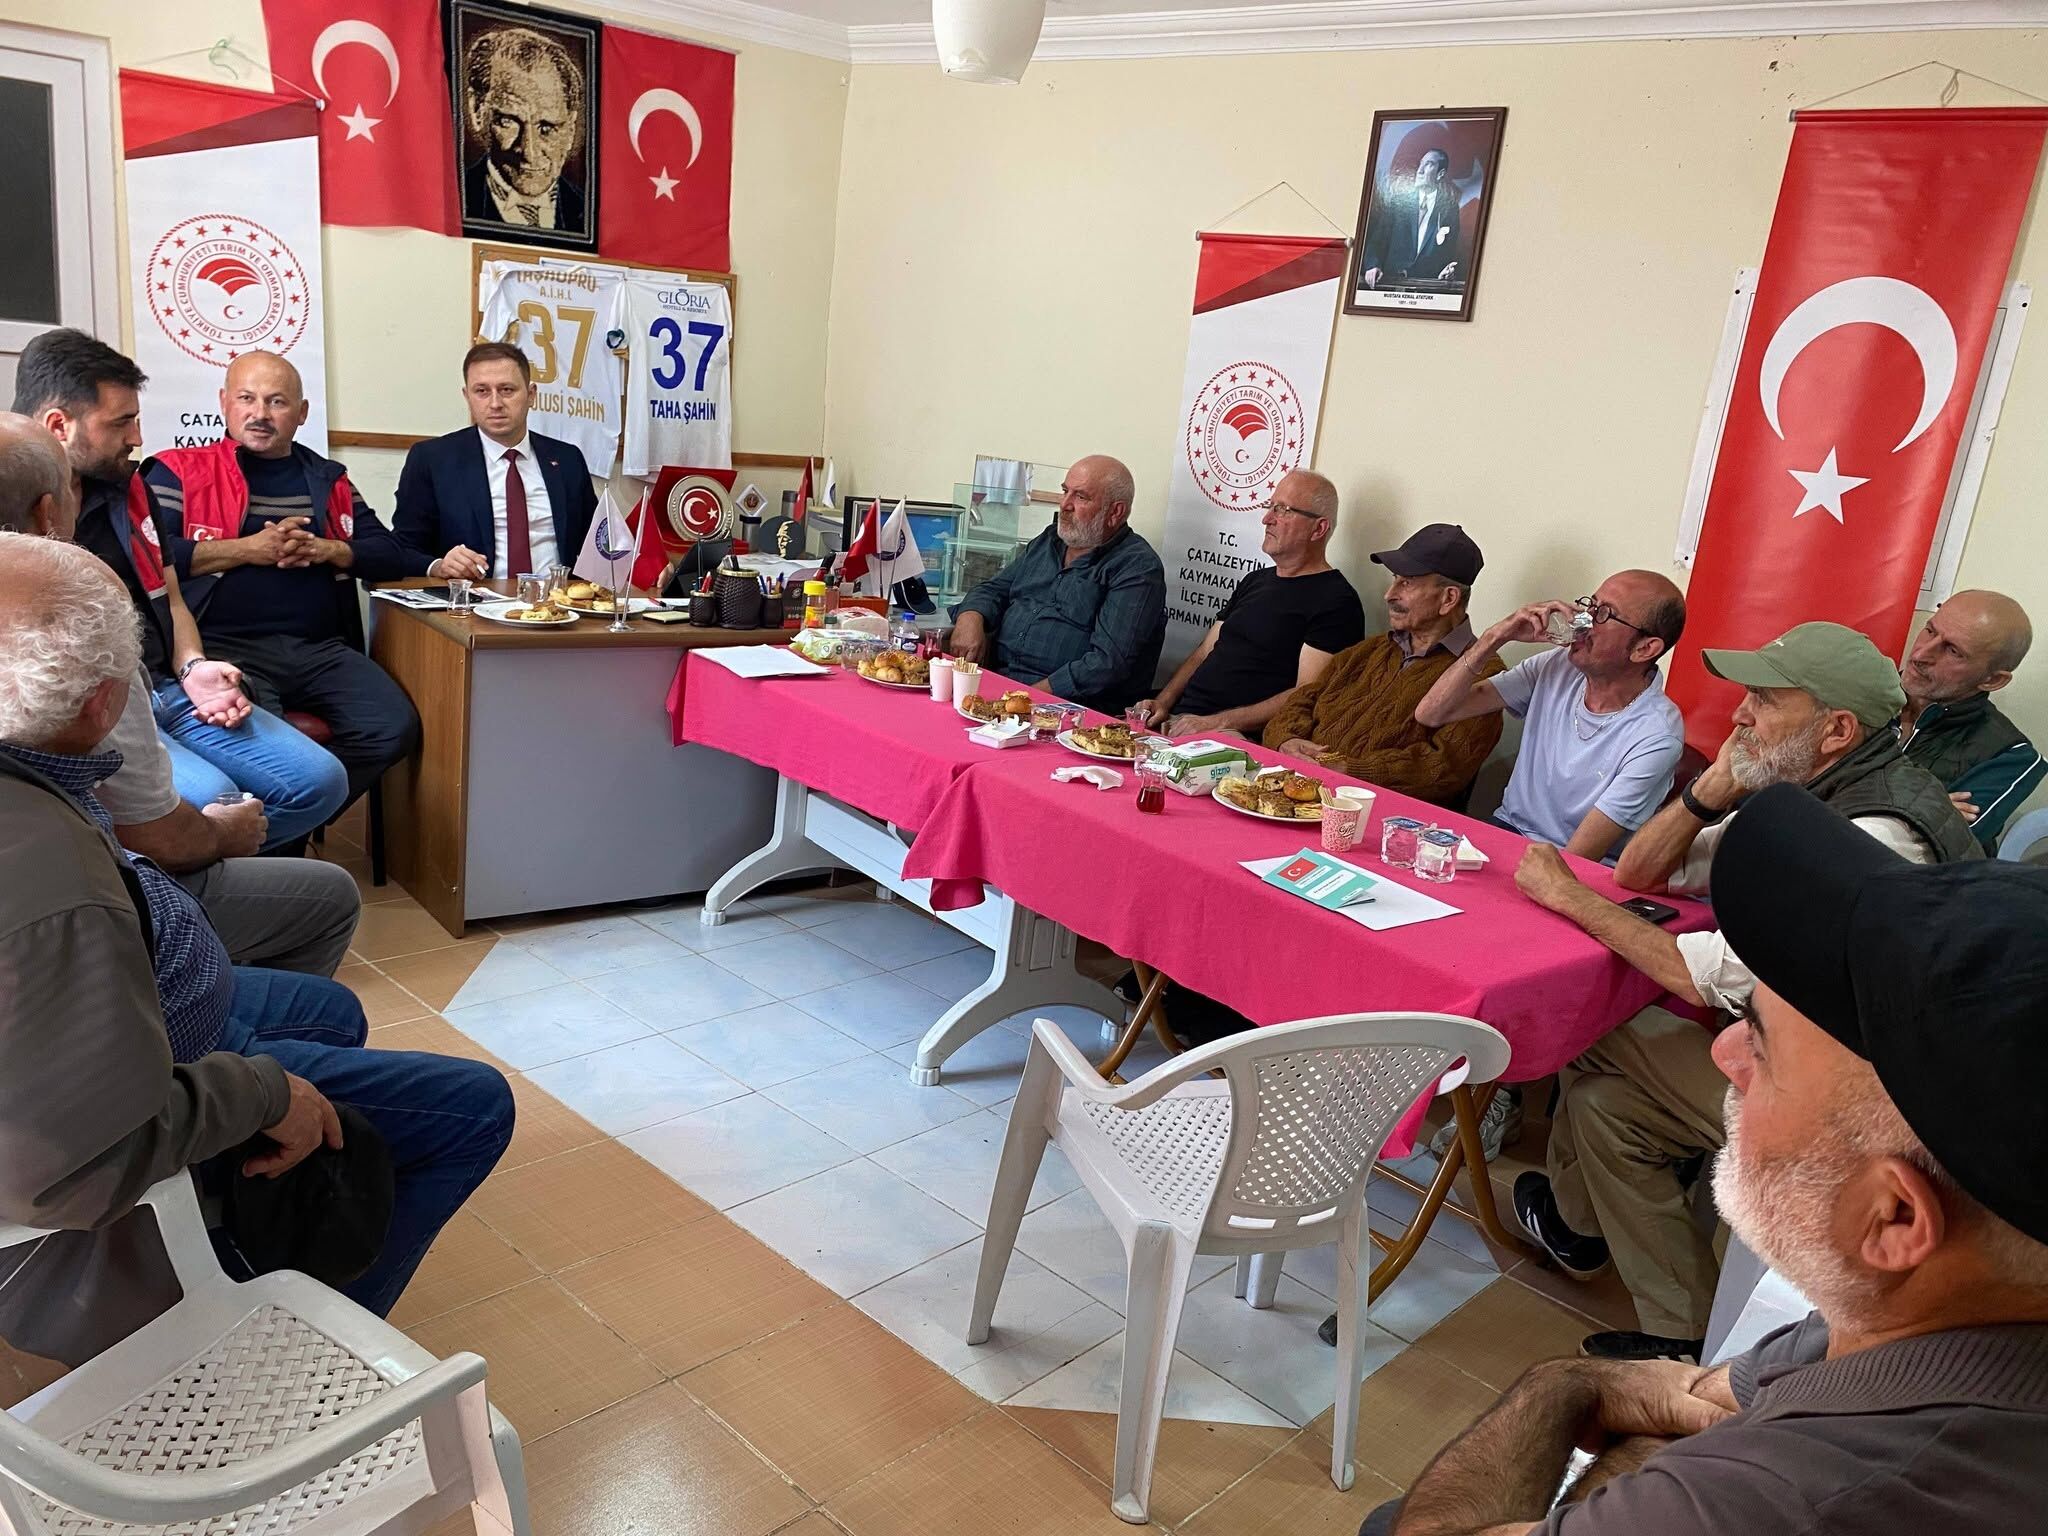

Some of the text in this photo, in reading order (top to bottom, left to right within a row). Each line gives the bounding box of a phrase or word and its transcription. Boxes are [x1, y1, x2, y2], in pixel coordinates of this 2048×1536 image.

[212, 243, 246, 256] TARIM
[249, 252, 261, 265] VE
[260, 264, 280, 299] ORMAN
[657, 289, 711, 310] GLORIA
[518, 300, 598, 389] 37
[649, 317, 724, 391] 37
[1239, 389, 1263, 401] TARIM
[1263, 397, 1274, 410] VE
[568, 396, 605, 423] ŞAHİN
[650, 398, 717, 424] TAHA ŞAHİN
[1271, 409, 1282, 445] ORMAN
[1244, 447, 1280, 484] BAKANLIĞI
[1219, 532, 1238, 547] T.C.
[1187, 547, 1266, 573] ÇATALZEYTİN
[1180, 587, 1205, 606] İLÇE
